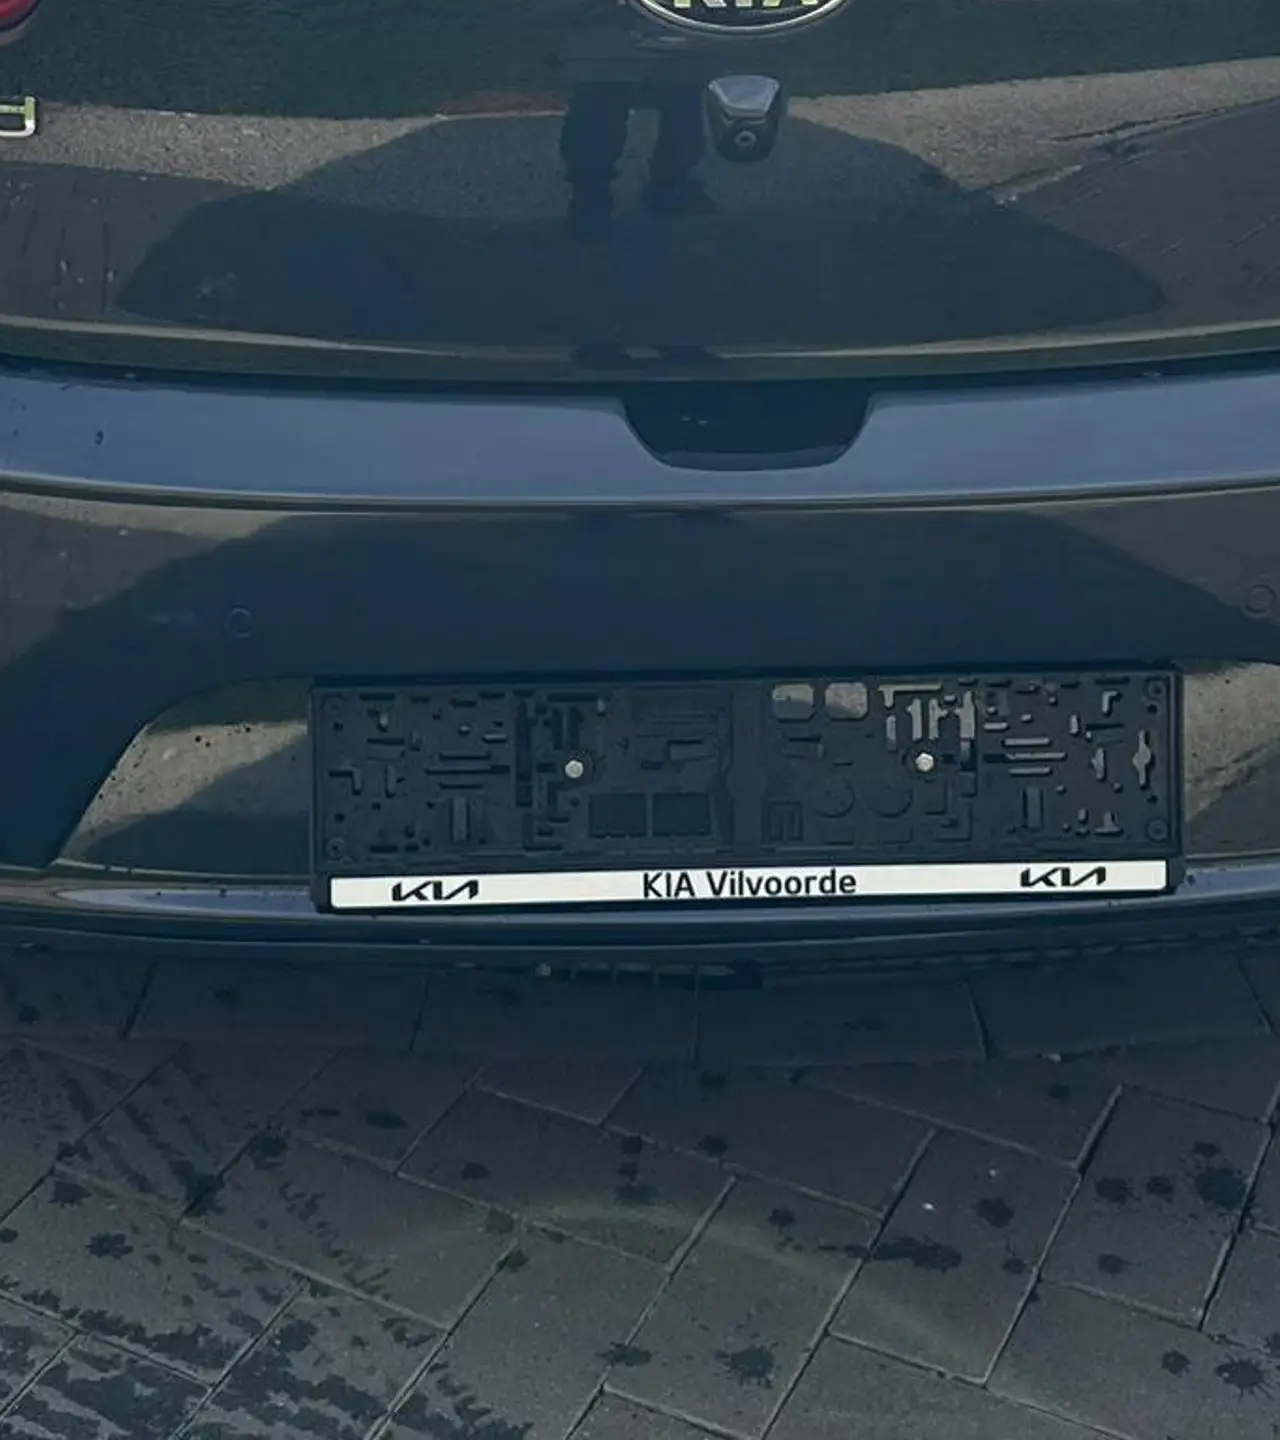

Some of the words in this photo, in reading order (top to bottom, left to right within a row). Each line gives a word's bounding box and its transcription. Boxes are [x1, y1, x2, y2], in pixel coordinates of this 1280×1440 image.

[644, 872, 695, 897] KIA
[706, 868, 857, 897] Vilvoorde
[1021, 866, 1107, 887] KIA
[391, 880, 479, 902] KIA
